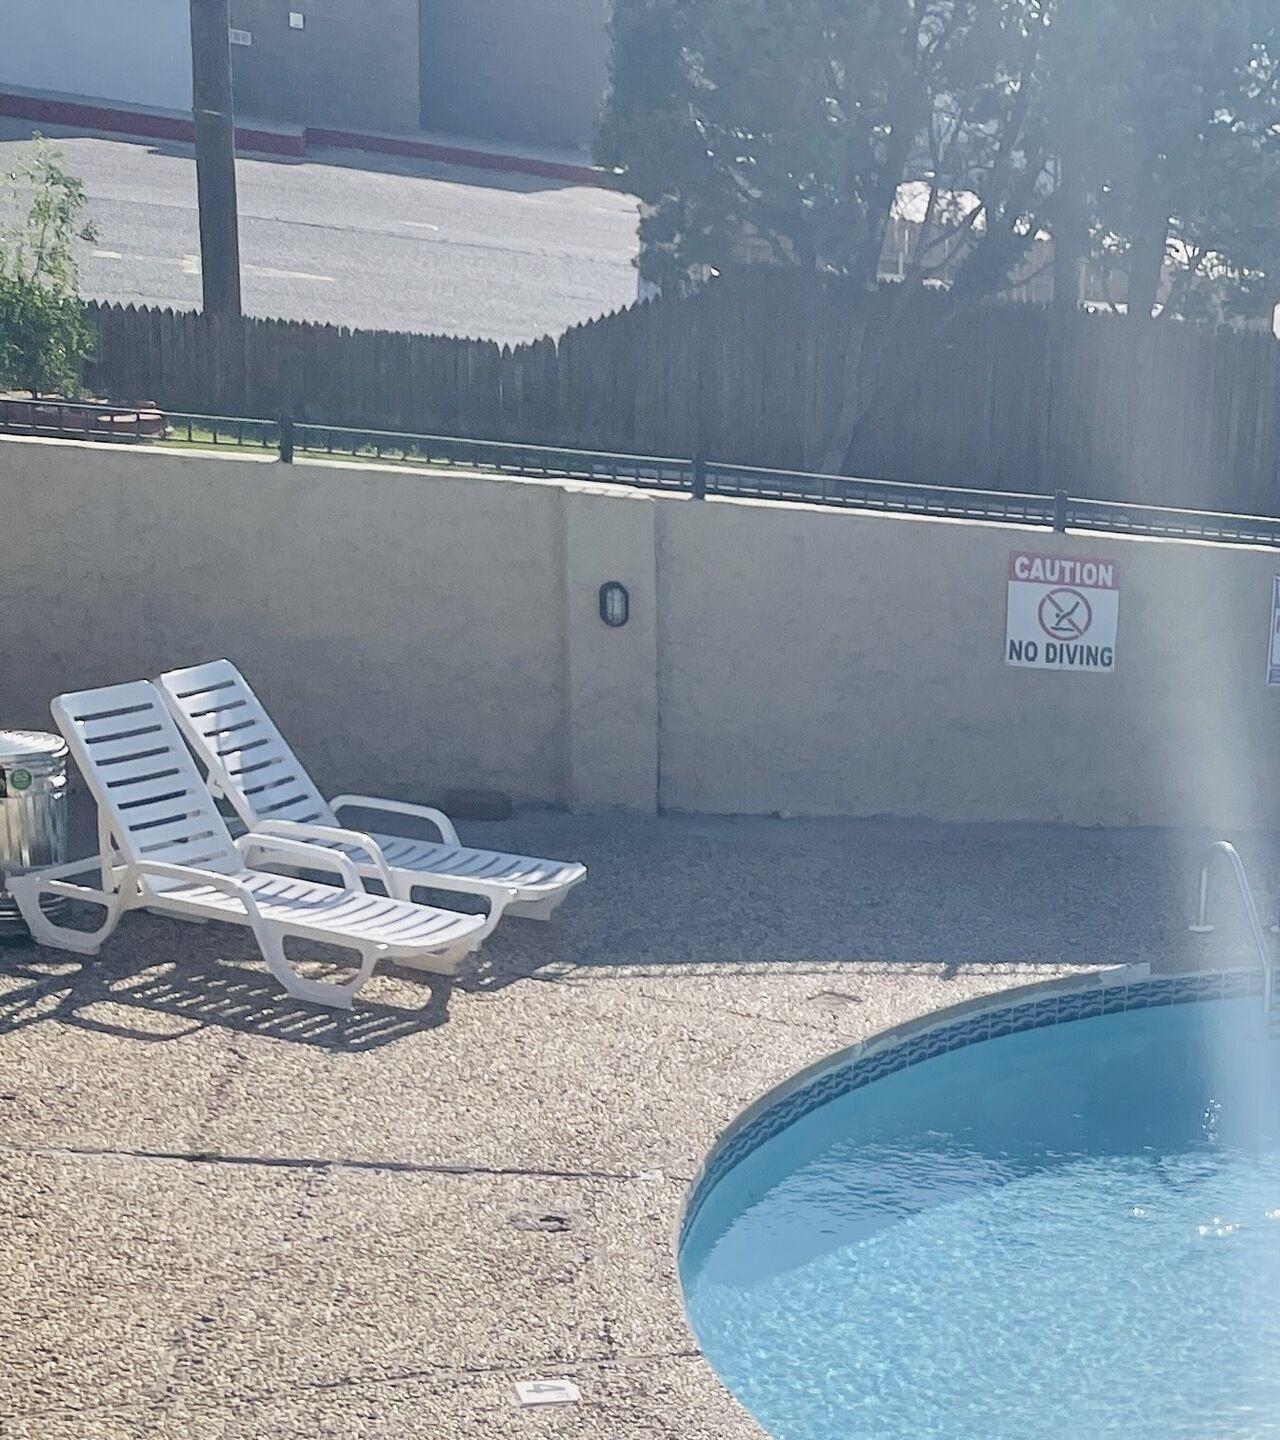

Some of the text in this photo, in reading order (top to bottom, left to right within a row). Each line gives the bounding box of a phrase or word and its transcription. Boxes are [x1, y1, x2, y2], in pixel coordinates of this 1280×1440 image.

[1014, 556, 1112, 586] CAUTION
[1009, 639, 1112, 667] NO DIVING
